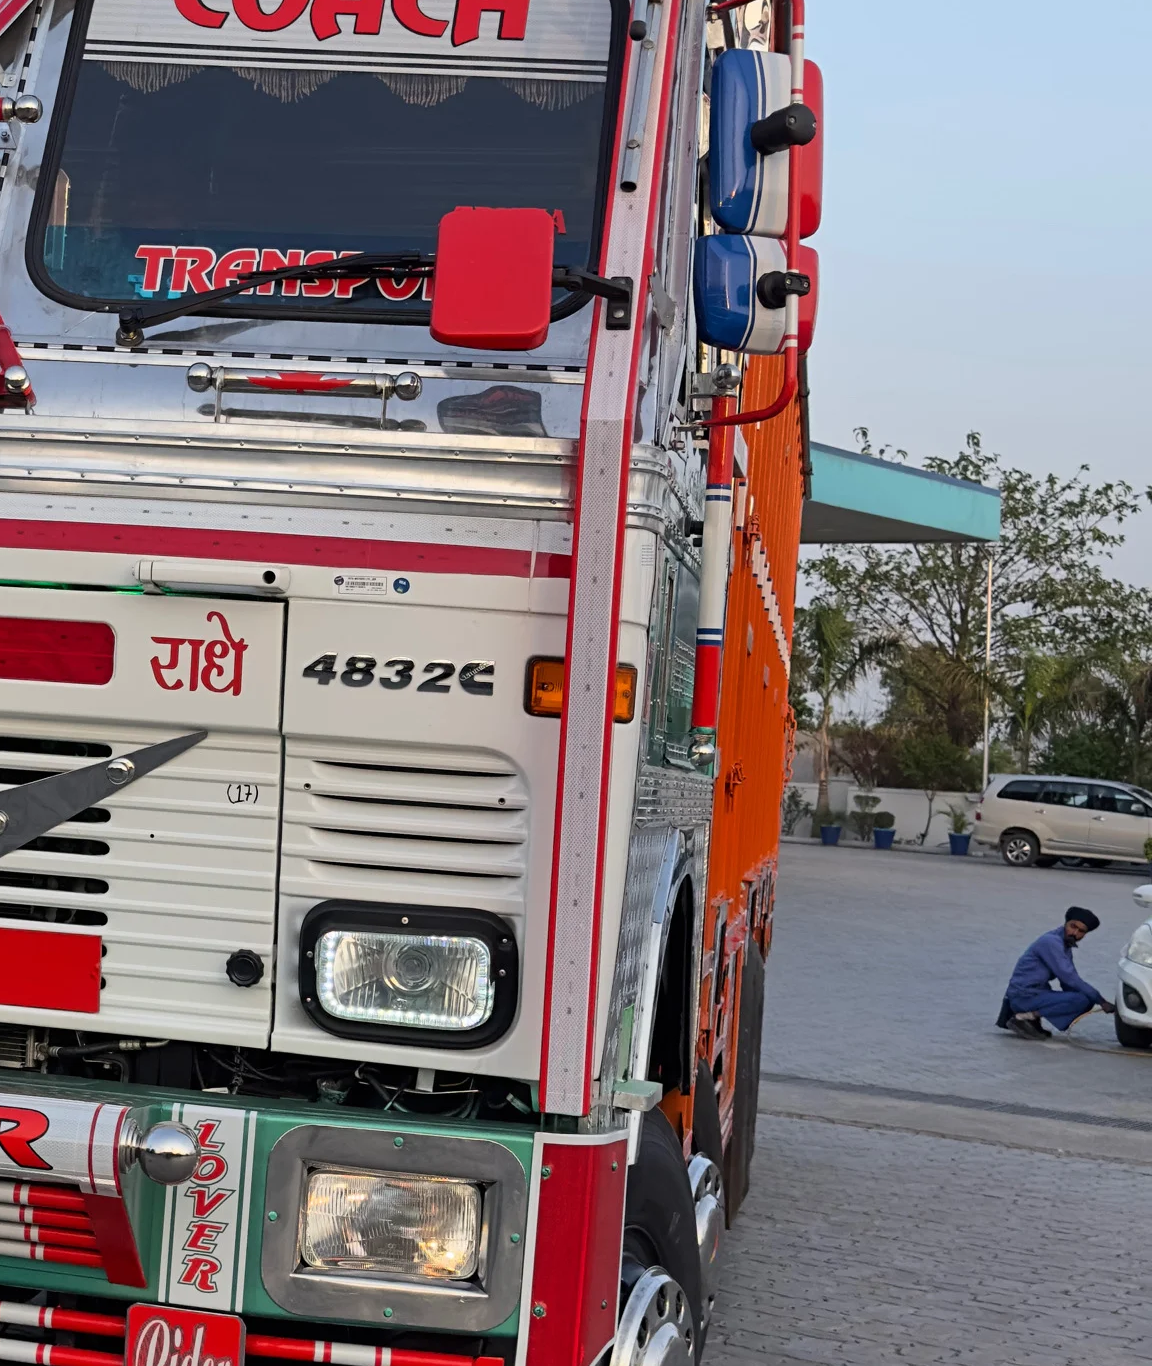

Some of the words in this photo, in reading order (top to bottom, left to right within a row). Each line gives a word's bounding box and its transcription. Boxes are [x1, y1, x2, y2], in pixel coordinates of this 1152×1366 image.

[149, 610, 249, 697] राधे
[226, 783, 259, 805] (17)
[178, 1118, 237, 1294] LOVER
